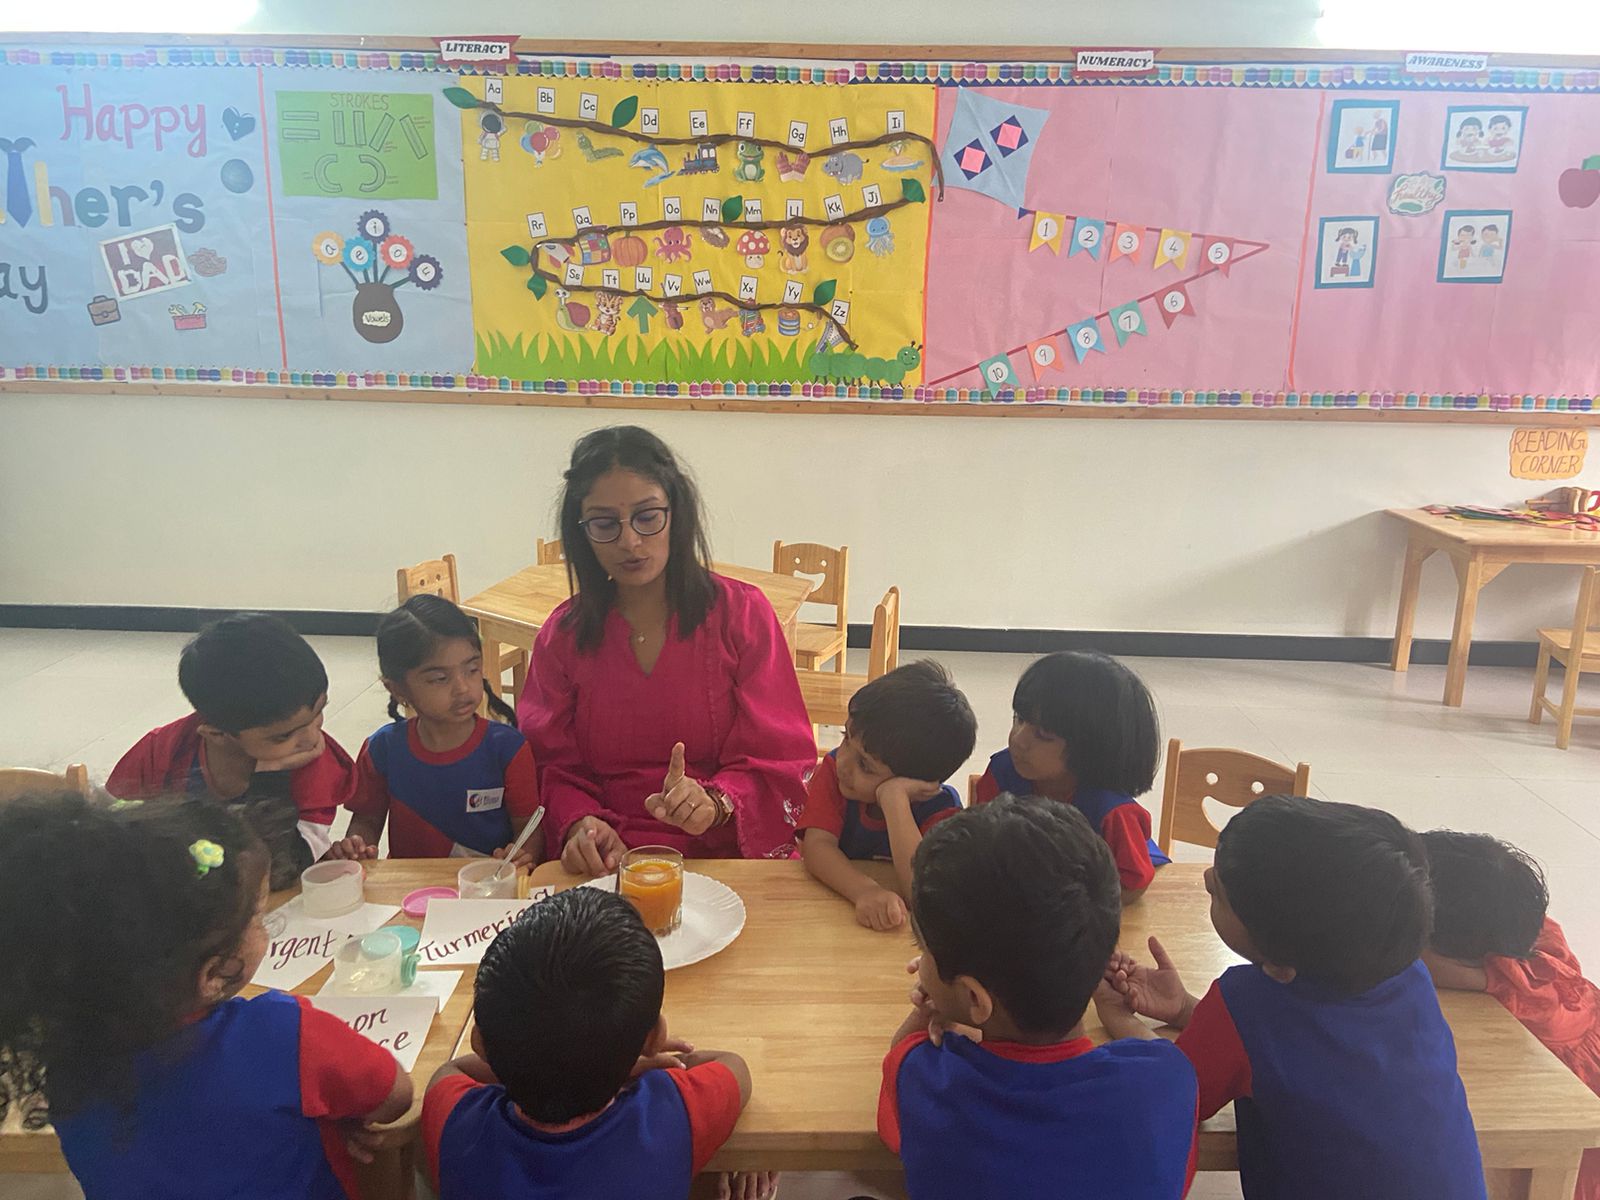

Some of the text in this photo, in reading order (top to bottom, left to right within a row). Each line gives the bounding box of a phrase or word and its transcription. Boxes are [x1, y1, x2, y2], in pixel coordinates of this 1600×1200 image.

[445, 42, 507, 54] LITERACY
[1079, 55, 1152, 68] NUMERACY
[1407, 55, 1484, 69] AWARENESS
[487, 82, 501, 95] Aa
[329, 92, 390, 111] STROKES
[540, 92, 553, 104] Bb
[583, 99, 596, 112] Cc
[56, 83, 207, 158] Happy
[643, 113, 657, 126] Dd
[692, 117, 706, 129] Ee
[738, 117, 753, 130] Ff
[891, 116, 901, 129] Ii
[791, 128, 805, 143] Gg
[832, 126, 847, 137] Hh
[868, 190, 879, 205] Jj
[622, 208, 636, 221] Pp
[666, 203, 680, 215] Oo
[705, 204, 719, 216] Nn
[745, 206, 762, 216] Mm
[789, 204, 799, 217] Ll
[828, 202, 842, 214] Kk
[531, 219, 544, 231] Rr
[575, 214, 592, 226] Qq
[372, 220, 379, 234] i
[1042, 222, 1050, 237] 1
[1084, 230, 1095, 242] 2
[1123, 235, 1134, 250] 3
[118, 242, 132, 265] I
[1168, 240, 1179, 254] 4
[1214, 247, 1224, 260] 5
[324, 243, 431, 277] a e o u
[117, 254, 186, 294] DAD
[568, 268, 581, 281] Ss
[605, 274, 618, 285] Tt
[637, 273, 650, 284] Uu
[667, 280, 680, 292] Vv
[694, 277, 711, 287] Ww
[742, 282, 754, 294] Xx
[787, 285, 800, 300] Yy
[1169, 294, 1178, 308] 6
[364, 313, 390, 324] Vowels
[834, 305, 846, 319] Zz
[1123, 315, 1134, 330] 7
[1083, 331, 1091, 345] 8
[1038, 348, 1048, 362] 9
[992, 367, 1005, 381] 10
[1512, 430, 1586, 453] READING
[1519, 455, 1581, 474] CORNER
